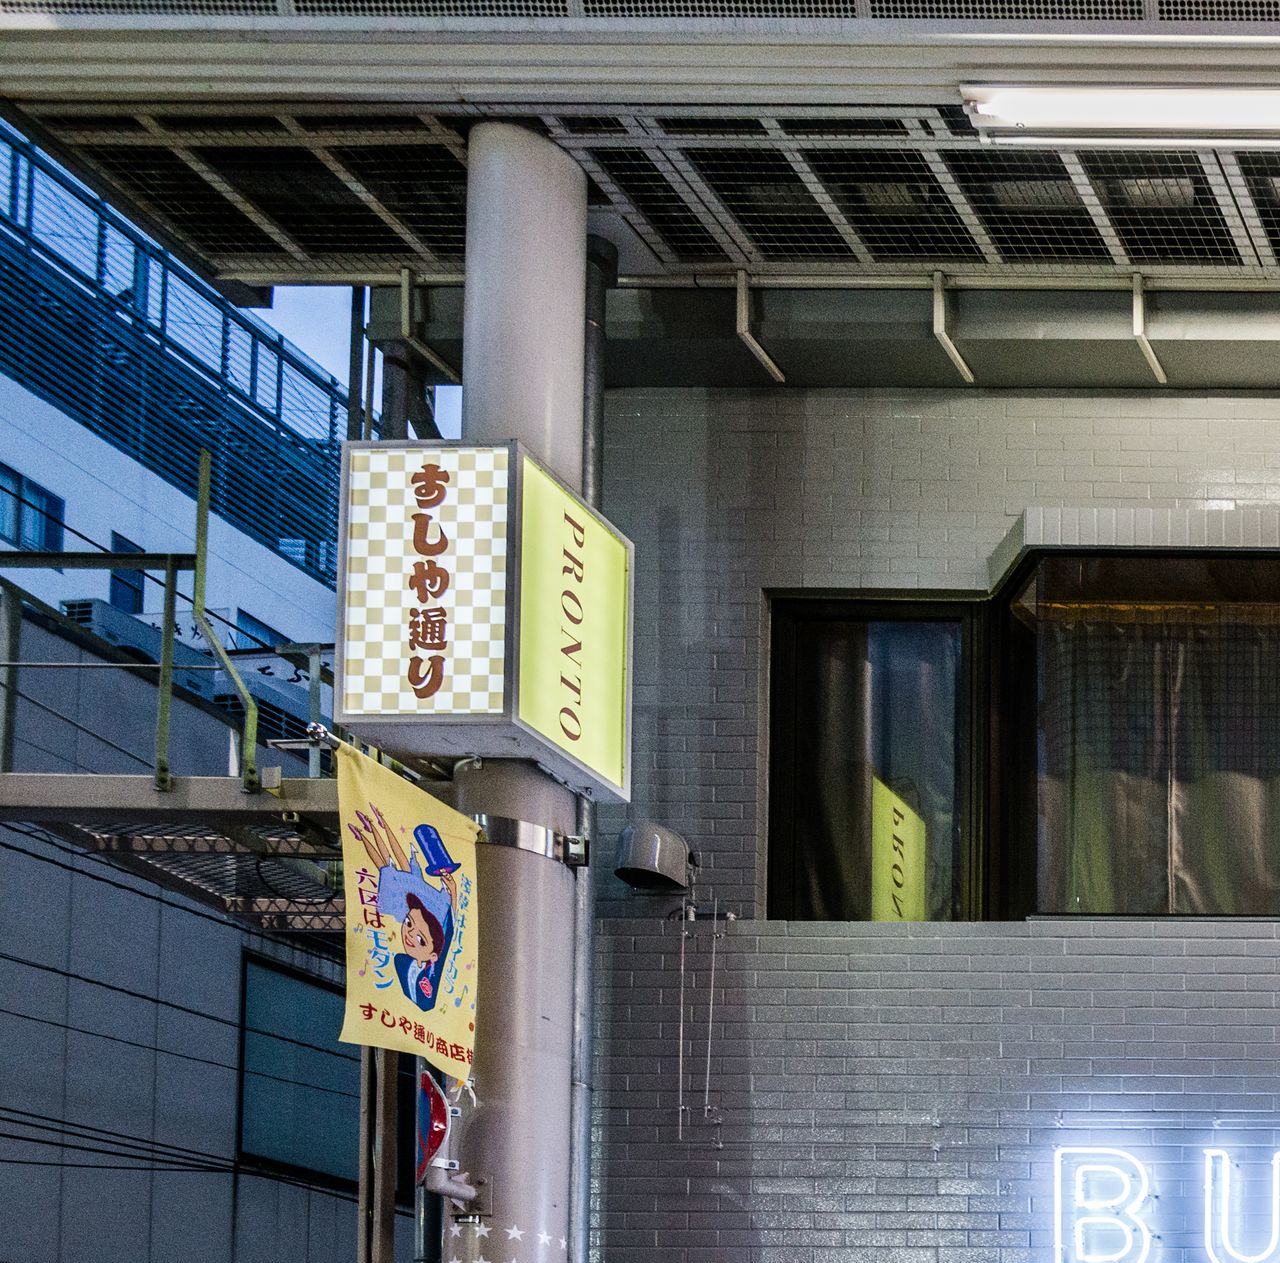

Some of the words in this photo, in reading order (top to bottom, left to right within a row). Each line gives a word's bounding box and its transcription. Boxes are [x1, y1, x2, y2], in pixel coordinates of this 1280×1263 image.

[408, 463, 451, 699] すしや通り
[558, 507, 586, 741] PRONTO
